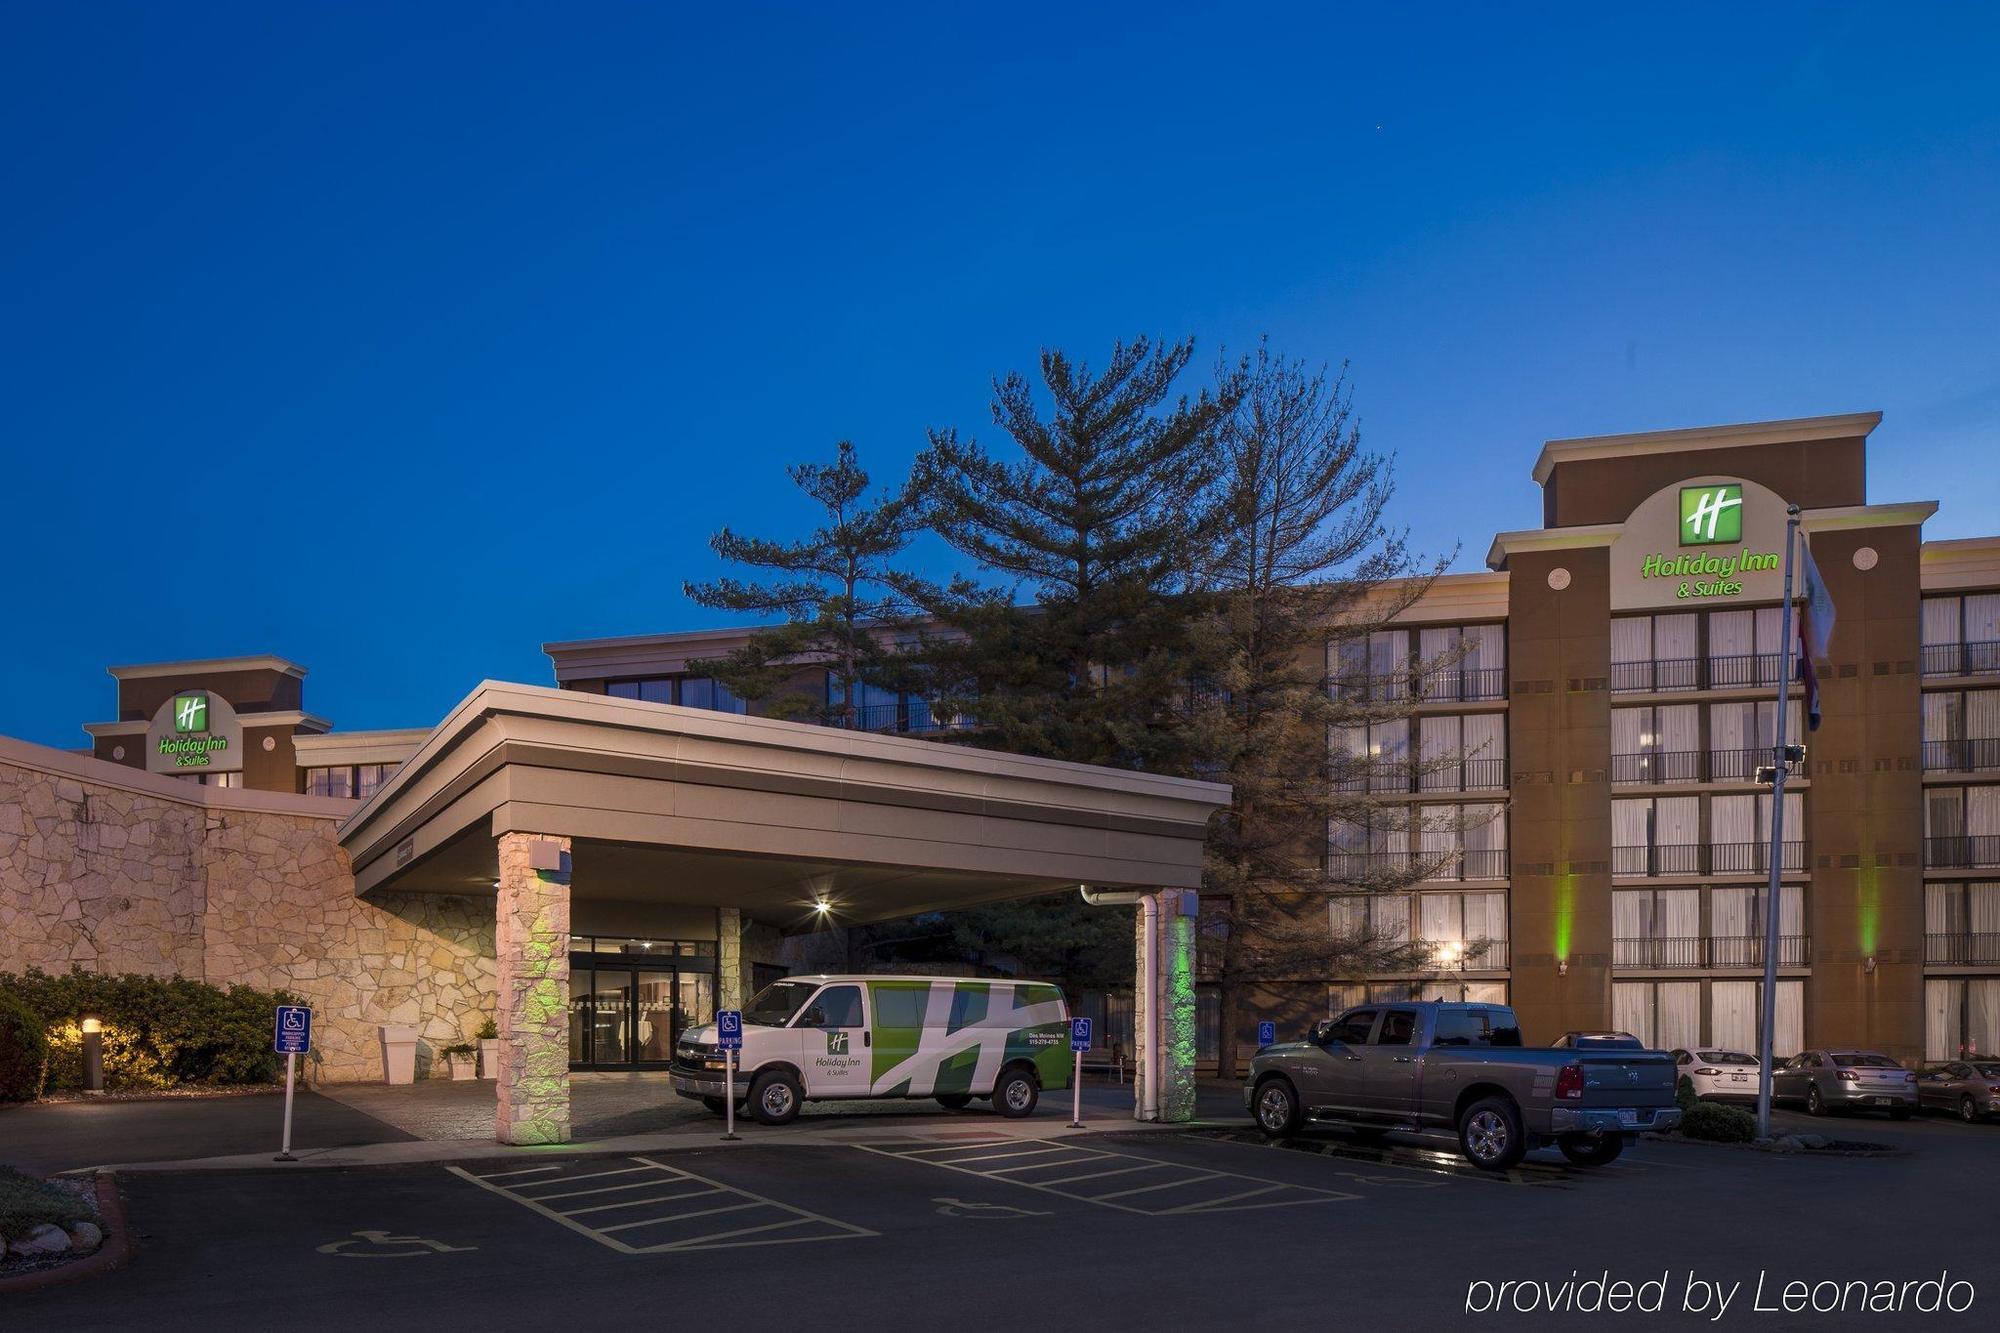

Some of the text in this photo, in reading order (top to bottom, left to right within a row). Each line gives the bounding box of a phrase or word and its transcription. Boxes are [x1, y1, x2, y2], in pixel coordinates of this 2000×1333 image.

[1642, 548, 1779, 579] Holiday Inn
[1677, 580, 1742, 598] & Suites
[159, 736, 227, 755] Holiday Inn
[176, 755, 210, 767] & Suites
[815, 1058, 860, 1068] Holiday Inn
